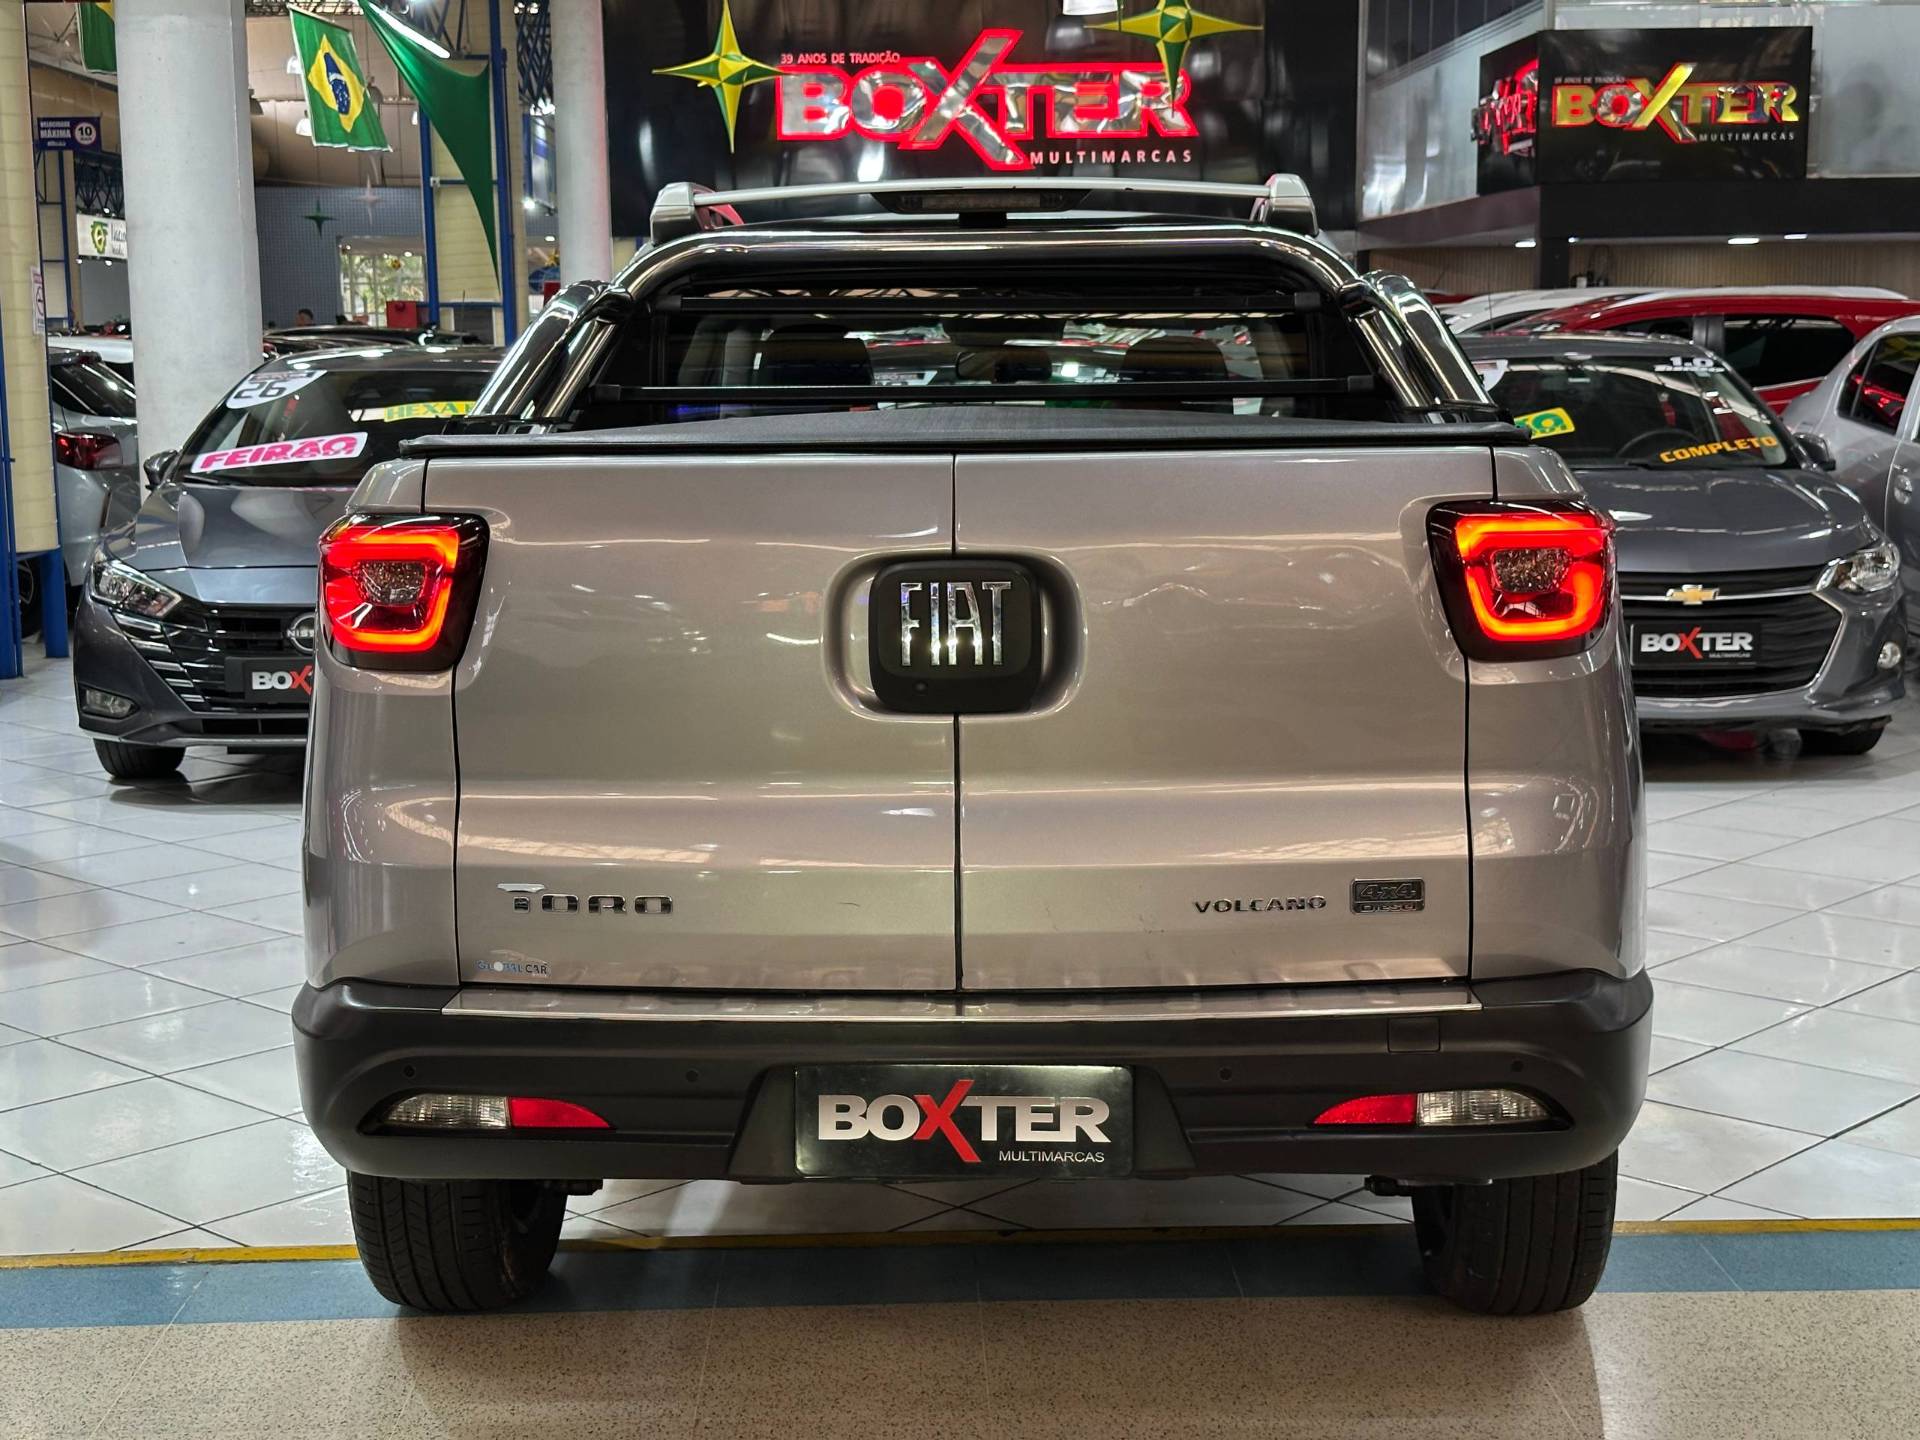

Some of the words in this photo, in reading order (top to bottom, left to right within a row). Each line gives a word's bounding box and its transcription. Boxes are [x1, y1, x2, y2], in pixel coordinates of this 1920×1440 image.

[780, 54, 794, 65] 39
[797, 53, 827, 65] ANOS
[831, 53, 845, 64] DE
[849, 51, 900, 65] TRADIÇÃO
[776, 28, 1199, 171] BOXTER
[1551, 62, 1799, 144] BOXTER
[40, 129, 71, 139] MÁXIMA
[78, 126, 93, 136] 10
[1700, 132, 1795, 141] MULTIMARCAS
[1030, 150, 1192, 164] MULTIMARCAS
[233, 379, 288, 399] 26
[1660, 436, 1777, 463] COMPLETO
[900, 581, 1012, 666] FIAT
[1641, 626, 1753, 659] BOXTER
[252, 665, 314, 695] BOX
[497, 883, 673, 915] TORO
[1194, 895, 1327, 913] VOLCANO
[525, 963, 548, 975] CAR
[817, 1079, 1112, 1163] BOXTER
[999, 1150, 1105, 1163] MULTIMARCAS
